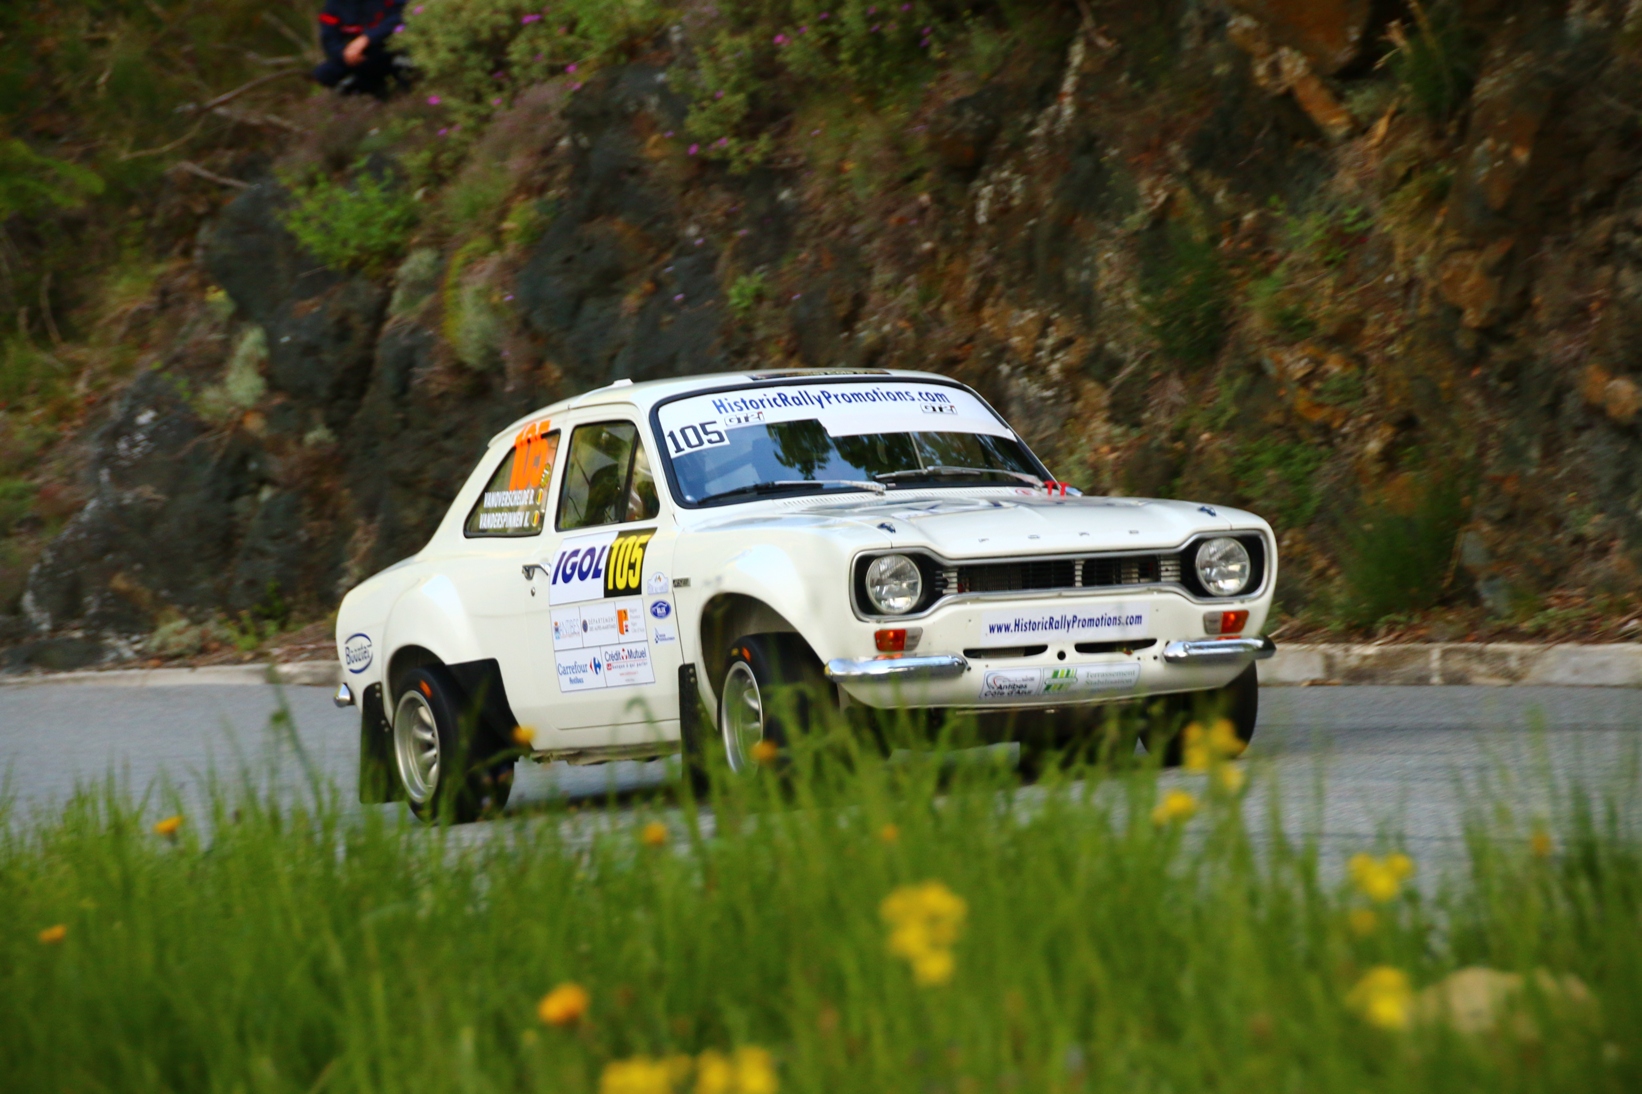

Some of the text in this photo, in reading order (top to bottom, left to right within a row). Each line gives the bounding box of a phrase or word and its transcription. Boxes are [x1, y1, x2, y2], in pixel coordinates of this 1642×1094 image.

[711, 387, 951, 414] HistoricRallyPromotions.com
[667, 420, 726, 453] 105
[551, 545, 607, 585] IGOL
[608, 535, 651, 590] 105
[988, 612, 1143, 634] www.HistoricRallyPromotions.com
[557, 660, 588, 676] Carrefour
[604, 647, 647, 662] Crédit Mutuel
